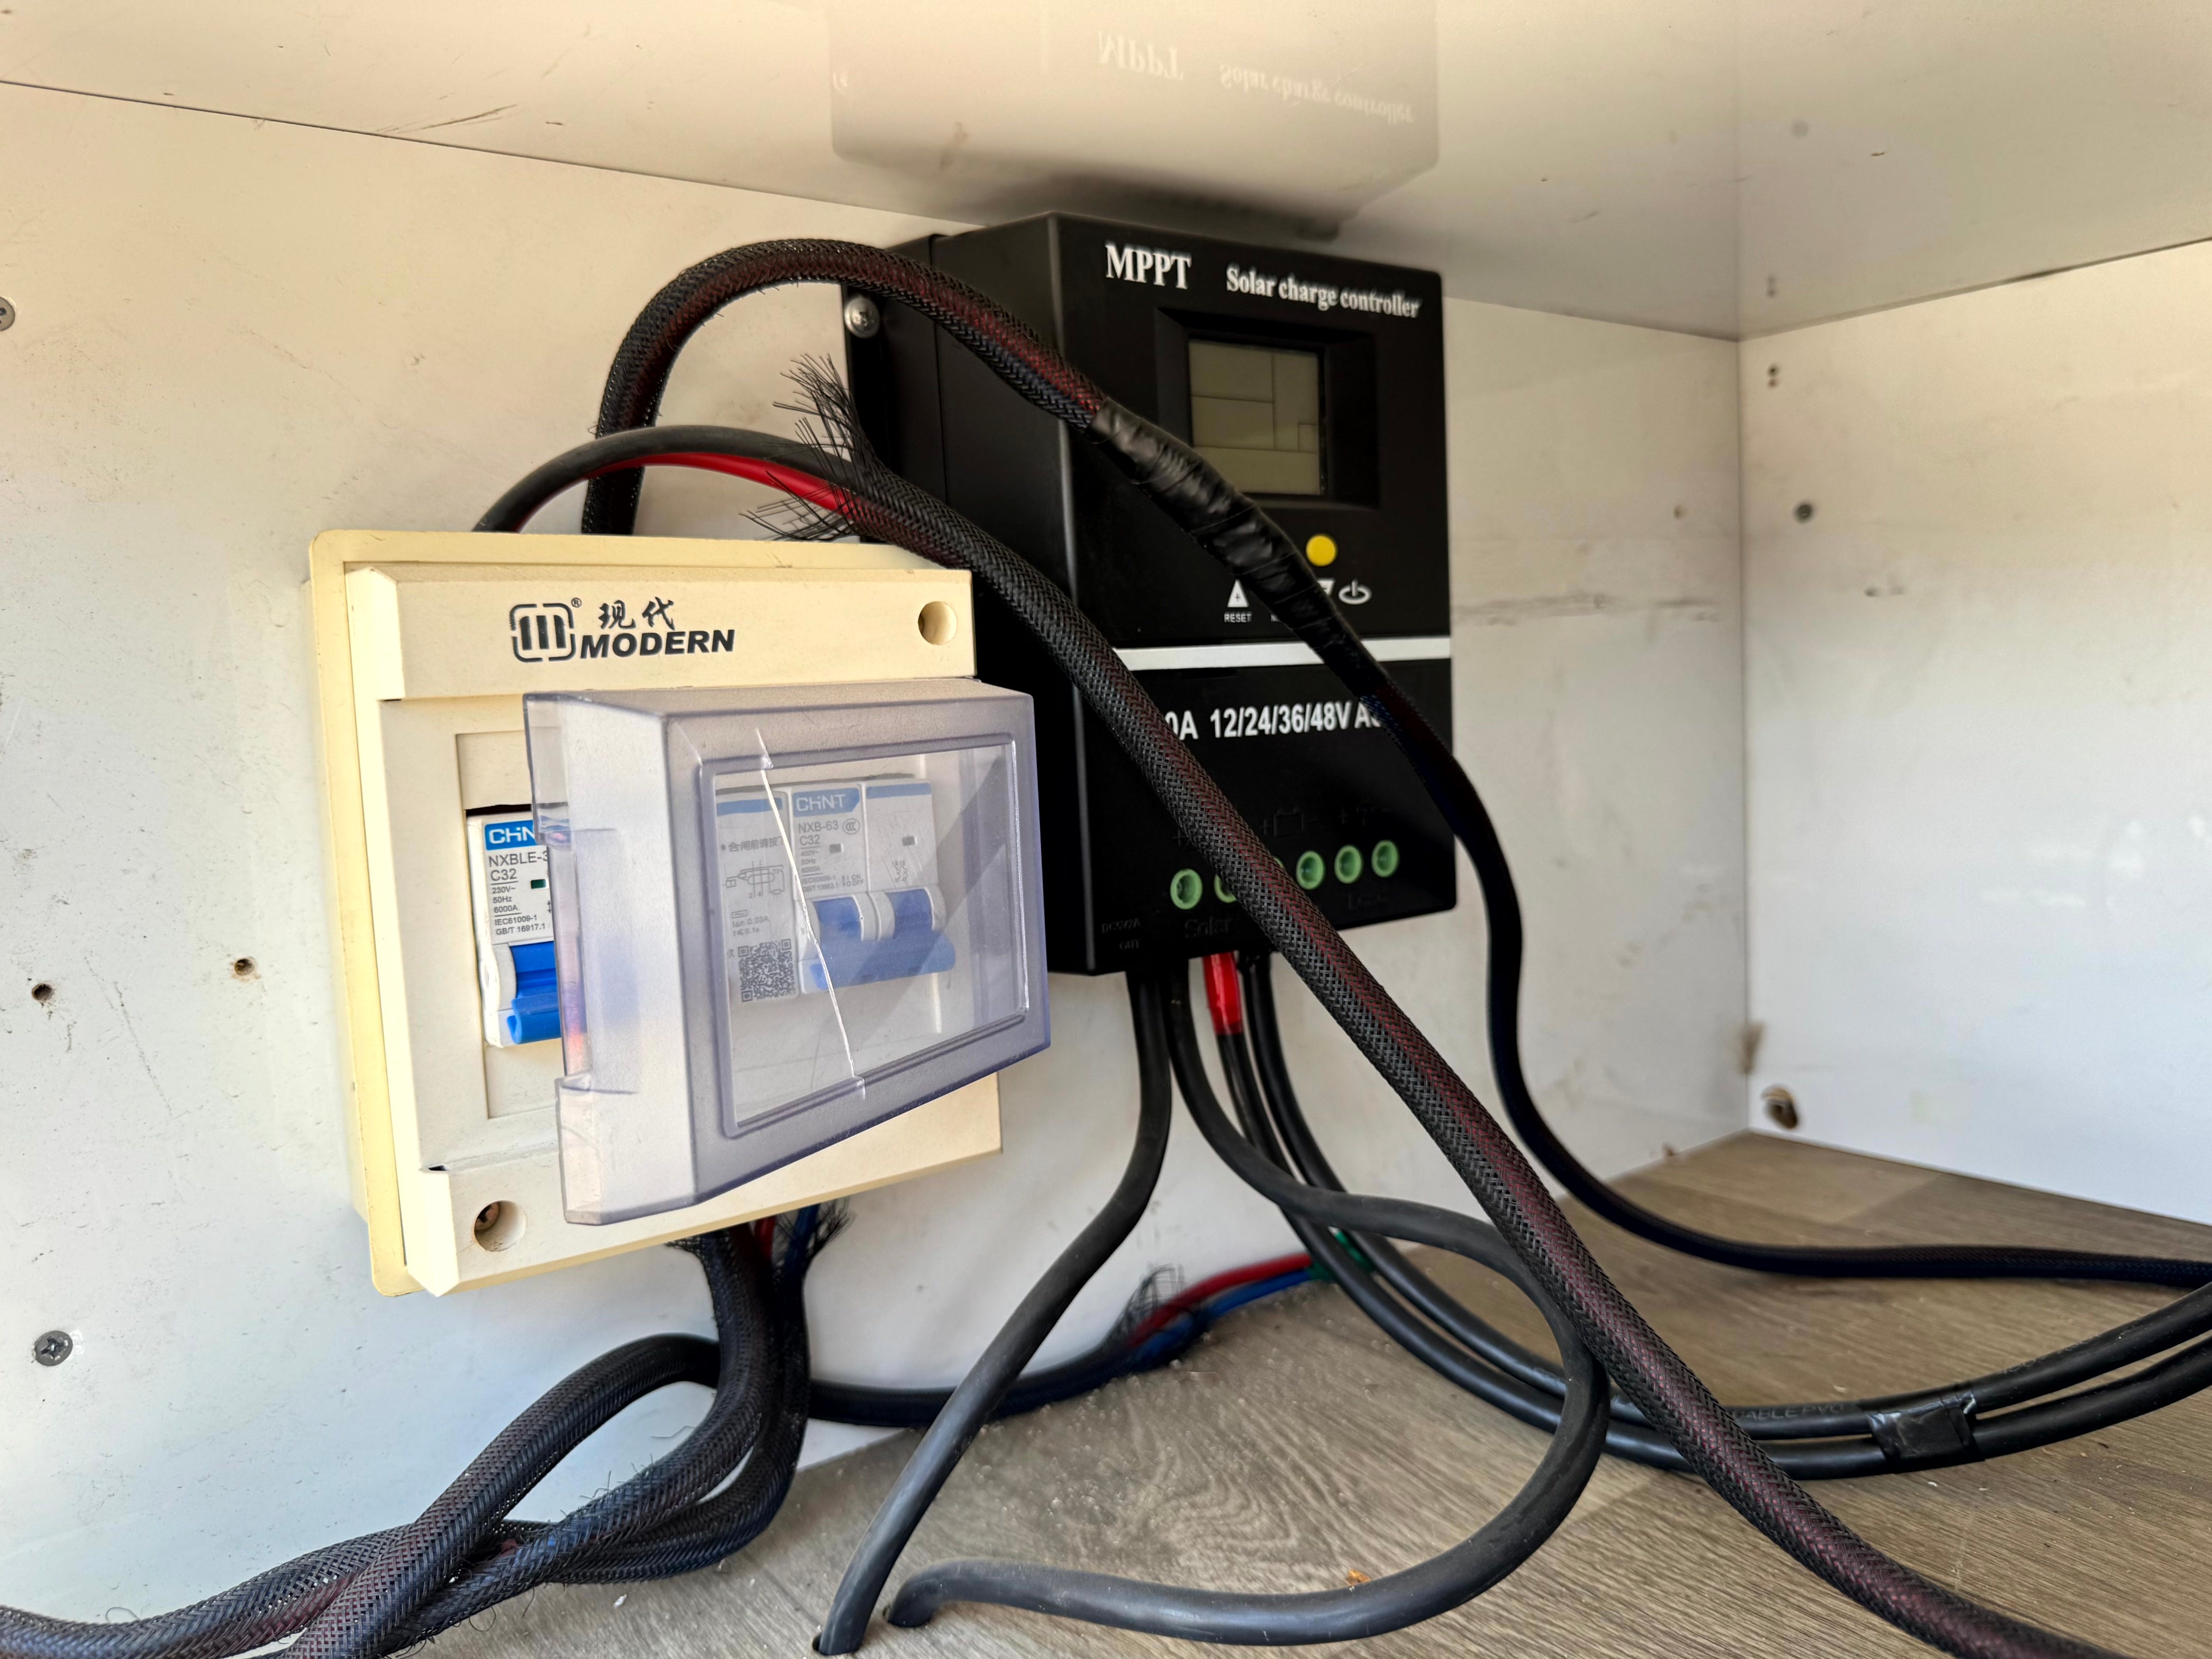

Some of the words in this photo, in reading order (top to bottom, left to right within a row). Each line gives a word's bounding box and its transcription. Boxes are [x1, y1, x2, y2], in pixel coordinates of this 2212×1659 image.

[1105, 242, 1191, 289] MPPT
[1226, 264, 1276, 296] Solar
[1279, 274, 1337, 311] charge
[1340, 287, 1422, 318] controller
[598, 597, 675, 630] 现代
[1224, 612, 1252, 623] RESET
[580, 630, 735, 659] MODERN
[1210, 700, 1352, 739] 12/24/36/48V
[1354, 701, 1381, 730] A
[798, 821, 839, 833] NXB-63
[800, 834, 821, 846] C32
[490, 868, 517, 881] C32
[494, 904, 518, 914] 6000A
[495, 915, 538, 926] IEC61009-1
[748, 915, 769, 925] 0.03A
[496, 926, 514, 935] GB/T
[517, 923, 546, 933] 16917.1
